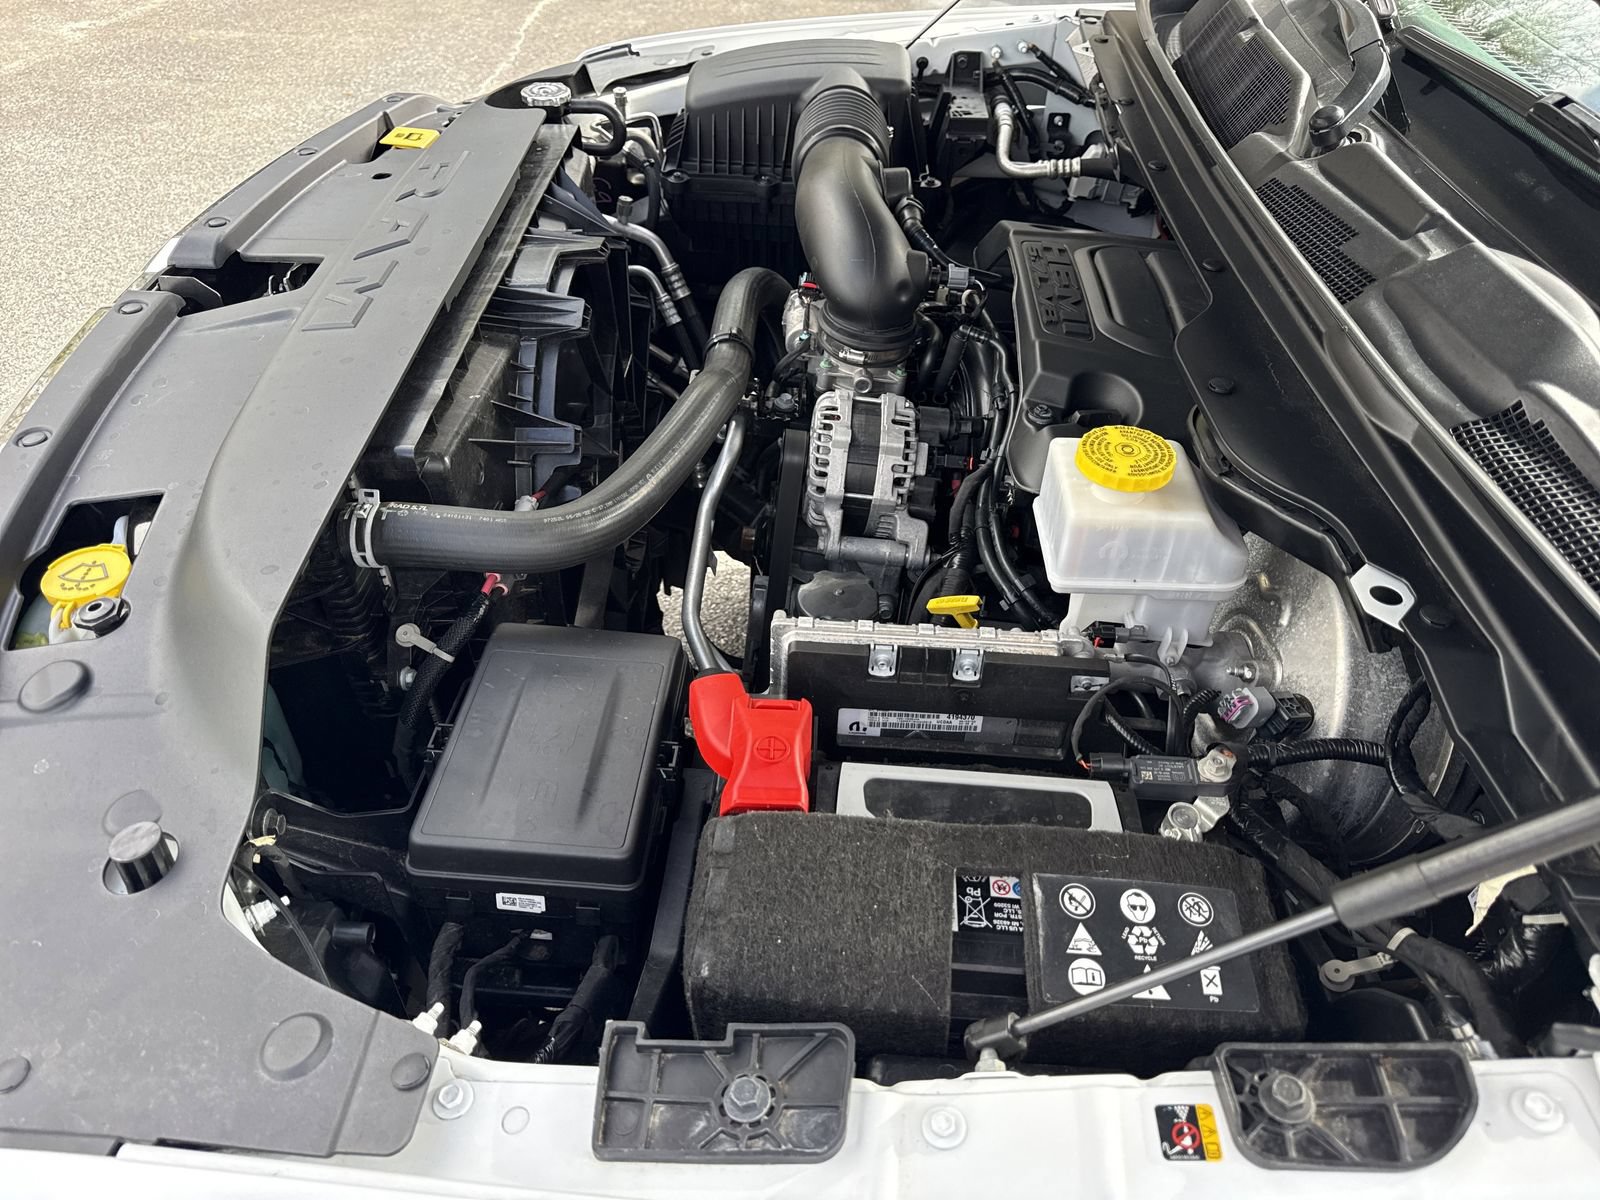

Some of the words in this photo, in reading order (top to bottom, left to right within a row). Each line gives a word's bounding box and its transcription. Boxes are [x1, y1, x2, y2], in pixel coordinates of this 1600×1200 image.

[302, 151, 471, 331] RAM
[1041, 242, 1089, 335] HEMI
[966, 887, 981, 896] Pb
[1121, 927, 1130, 940] LEAD
[1152, 926, 1166, 946] RETURN
